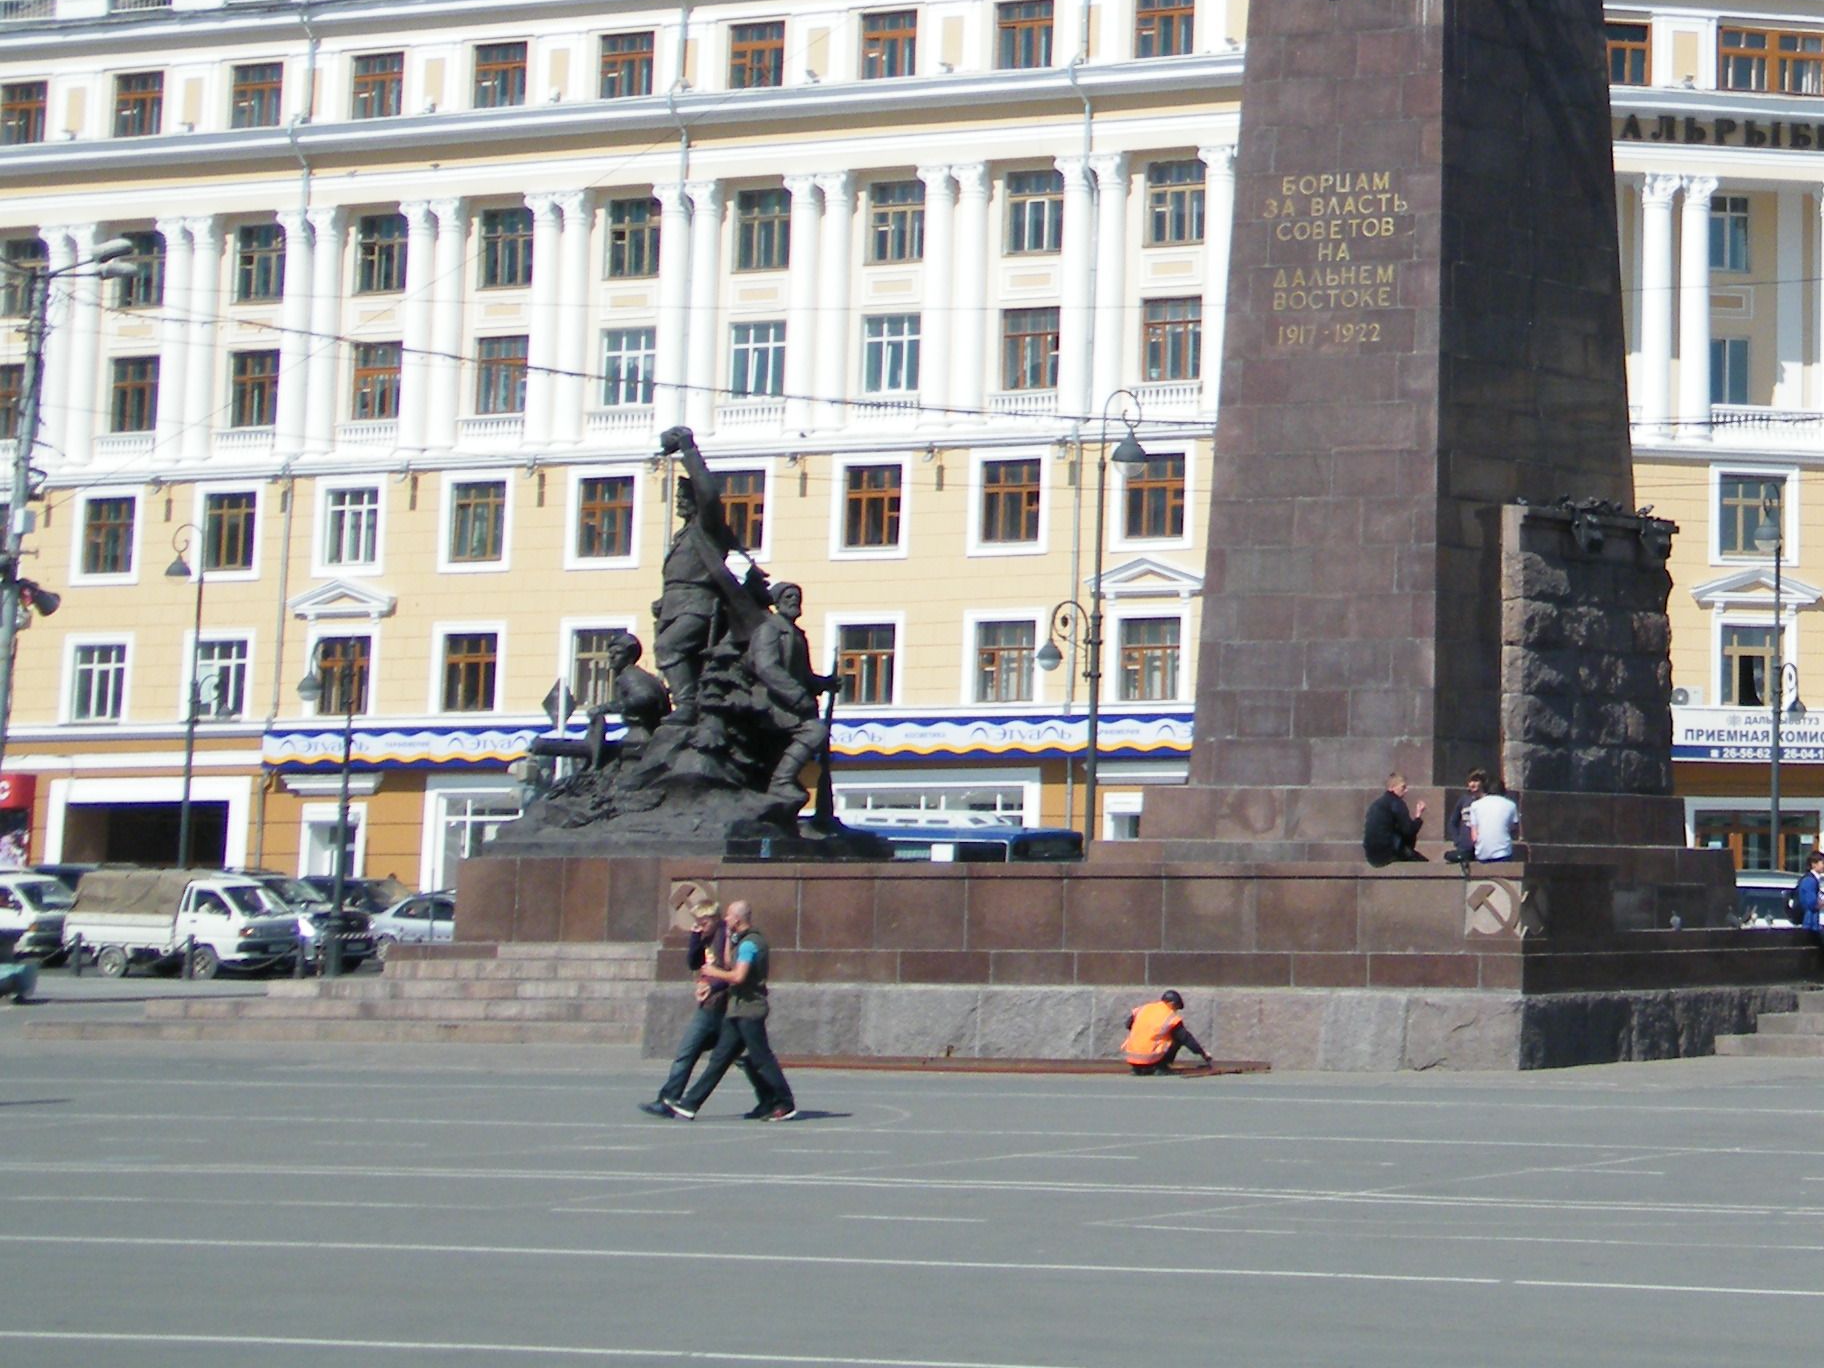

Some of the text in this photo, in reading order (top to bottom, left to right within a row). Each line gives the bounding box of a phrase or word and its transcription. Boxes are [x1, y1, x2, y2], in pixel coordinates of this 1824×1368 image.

[1282, 172, 1390, 195] БОРЦАМ
[1264, 193, 1408, 218] ЗА ВЛАСТЬ
[1277, 217, 1395, 241] СОВЕТОВ
[1318, 243, 1350, 262] НА
[1273, 264, 1394, 288] ДАЛЬНЕМ
[1273, 287, 1390, 310] ВОСТОКЕ
[1685, 728, 1770, 742] ПРИЕМНАЯ
